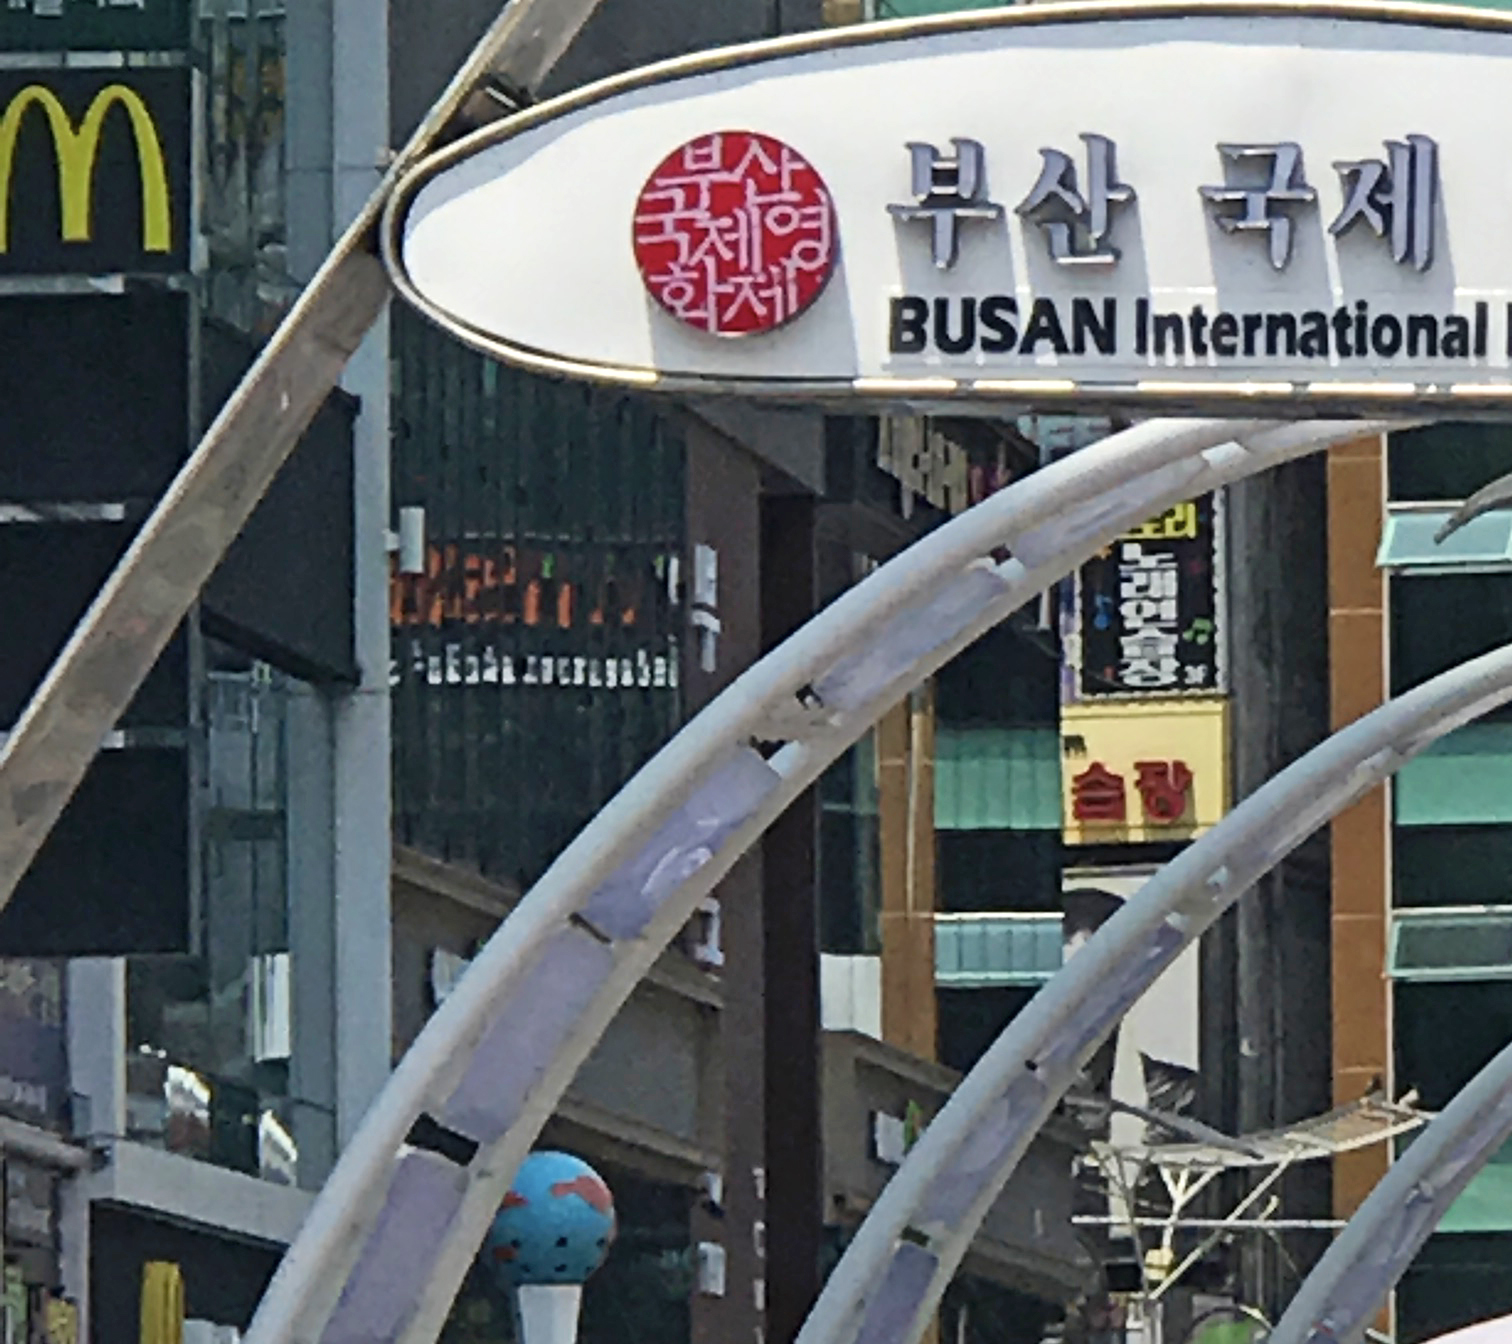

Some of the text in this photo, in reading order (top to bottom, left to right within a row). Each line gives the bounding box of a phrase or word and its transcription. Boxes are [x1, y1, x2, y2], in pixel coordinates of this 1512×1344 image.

[887, 134, 1135, 270] 부산
[1199, 134, 1445, 273] 국제
[889, 296, 1121, 358] BUSAN
[1134, 298, 1490, 359] International
[1119, 542, 1180, 687] 노래연습장
